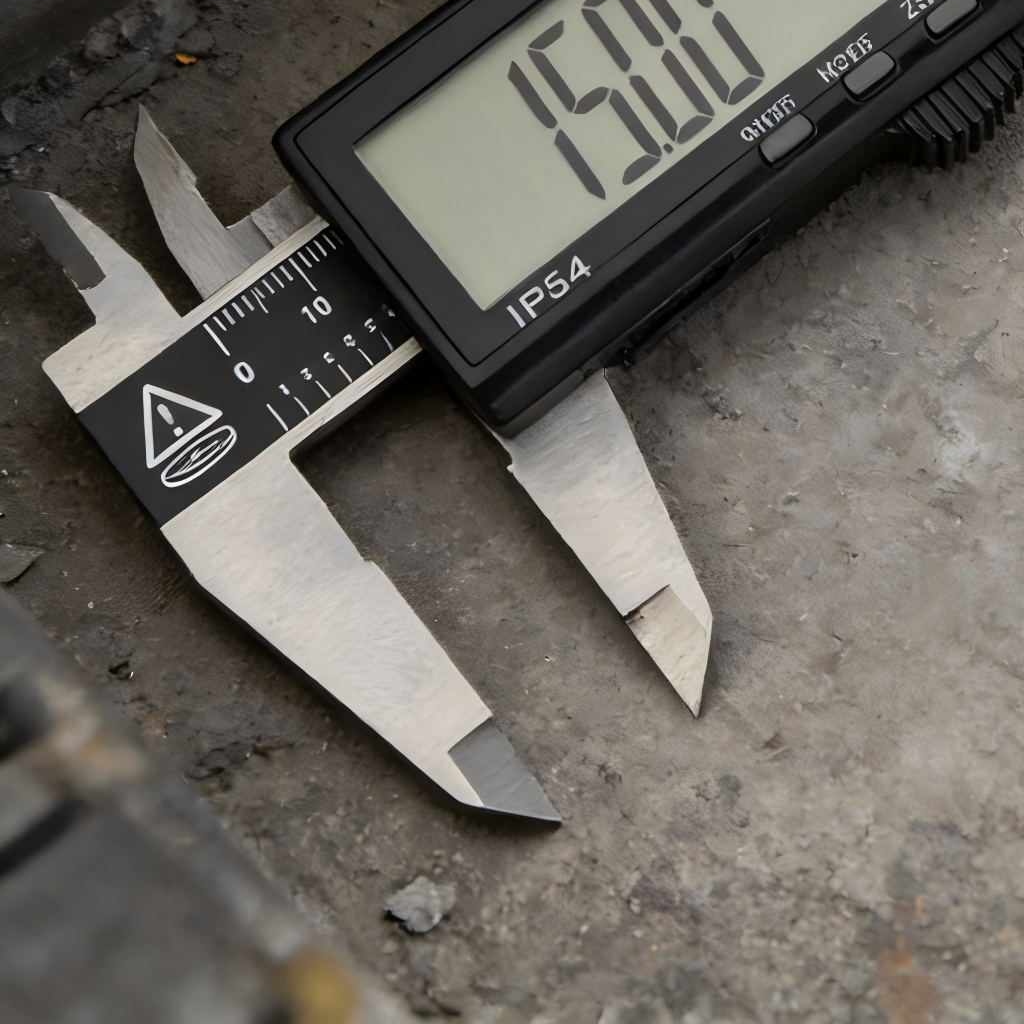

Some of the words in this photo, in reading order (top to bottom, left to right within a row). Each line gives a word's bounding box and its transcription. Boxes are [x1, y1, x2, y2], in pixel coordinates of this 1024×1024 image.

[506, 254, 592, 328] IP54
[233, 361, 255, 384] 0
[301, 295, 332, 324] 10
